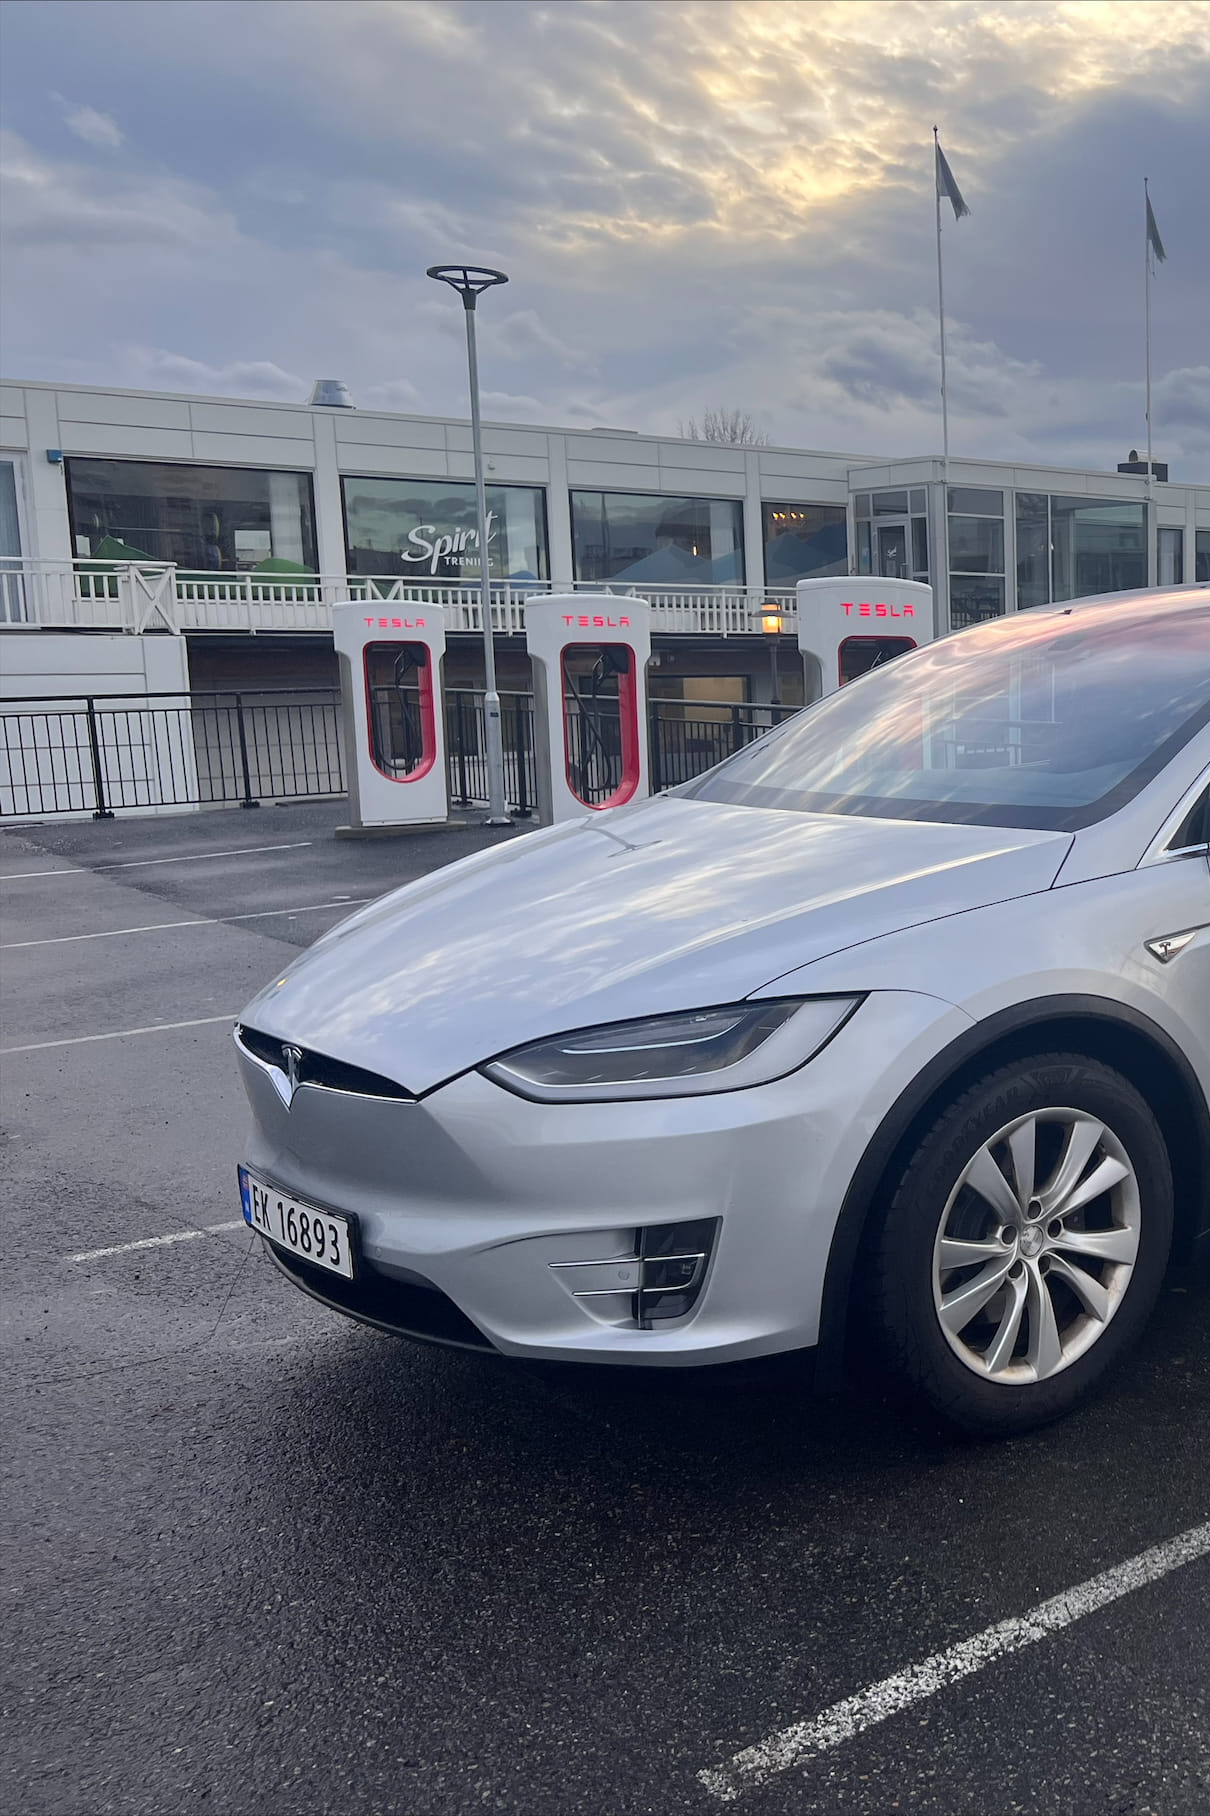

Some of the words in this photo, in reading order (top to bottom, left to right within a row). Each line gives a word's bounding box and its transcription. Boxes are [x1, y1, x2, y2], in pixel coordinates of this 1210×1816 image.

[840, 603, 914, 618] TESLA
[363, 617, 426, 629] TESLA
[561, 615, 630, 628] TESLA
[252, 1184, 272, 1233] EK
[277, 1201, 341, 1266] 16893
